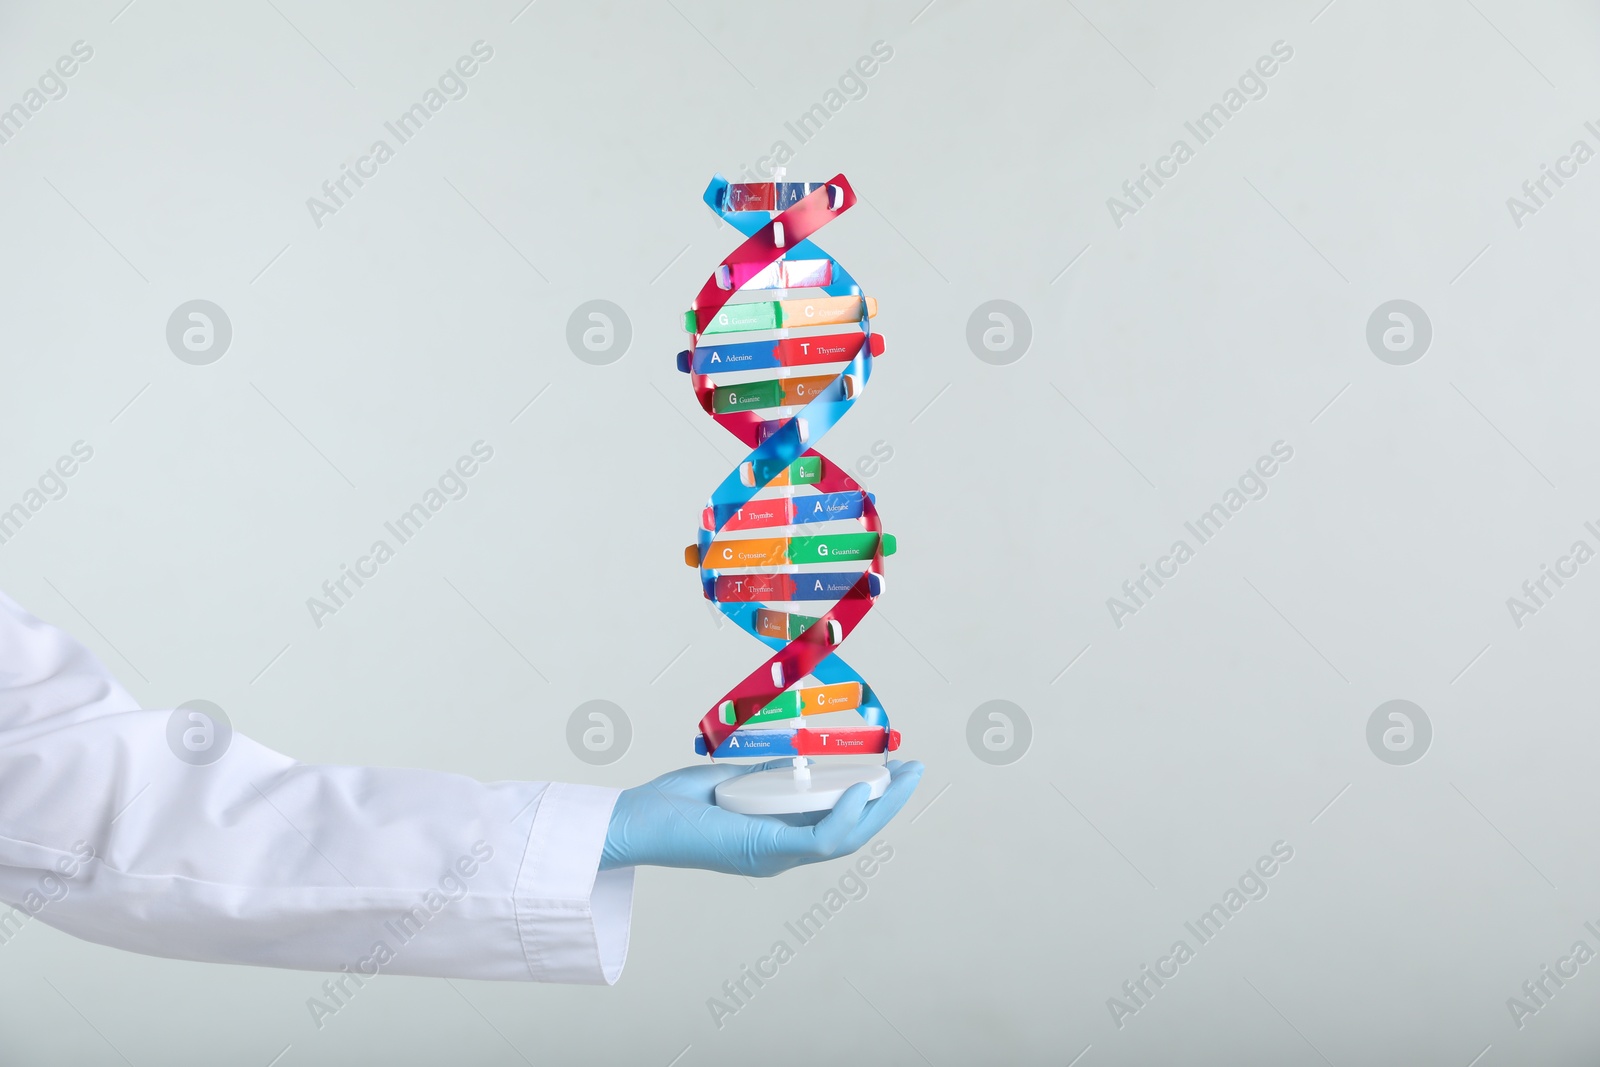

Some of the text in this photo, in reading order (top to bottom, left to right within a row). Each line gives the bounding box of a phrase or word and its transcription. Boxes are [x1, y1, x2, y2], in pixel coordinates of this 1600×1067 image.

[736, 190, 742, 202] T
[790, 189, 797, 201] A
[805, 305, 846, 319] C Cytosine
[719, 314, 758, 326] G Guanine
[800, 343, 846, 356] T Thymine
[711, 351, 753, 363] A Adenine
[797, 384, 805, 396] C
[729, 393, 760, 405] G Guanine
[763, 427, 767, 438] A
[800, 466, 805, 478] G
[814, 501, 849, 513] A Adenine
[749, 512, 774, 522] Thymine
[722, 548, 766, 561] C Cytosine
[817, 544, 860, 556] G Guanine
[735, 581, 774, 594] T Thymine
[814, 580, 823, 591] A
[764, 617, 769, 629] C
[817, 694, 849, 706] C Cytosine
[762, 706, 783, 715] Guanine
[729, 736, 770, 748] A Adenine
[820, 734, 864, 748] T Thymine
